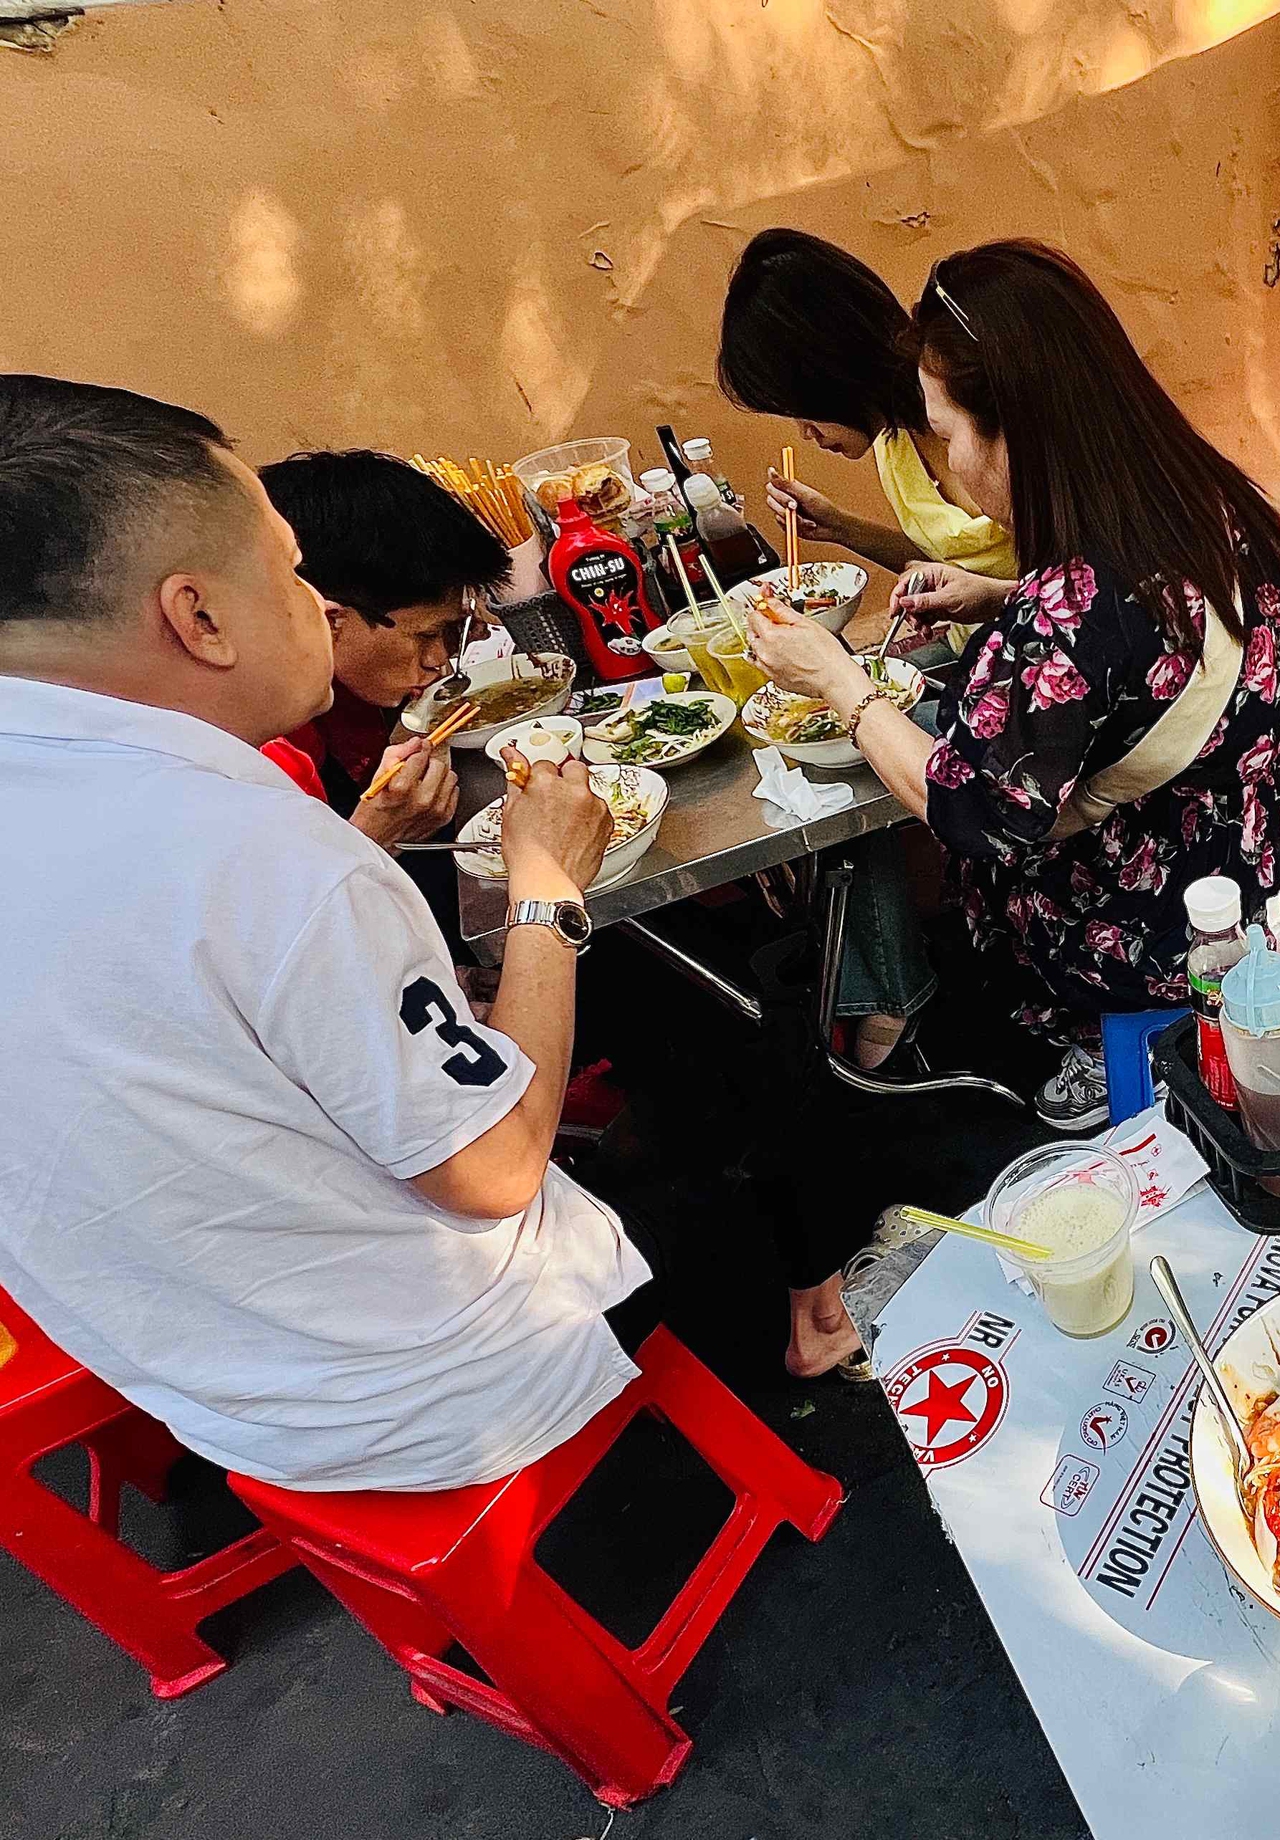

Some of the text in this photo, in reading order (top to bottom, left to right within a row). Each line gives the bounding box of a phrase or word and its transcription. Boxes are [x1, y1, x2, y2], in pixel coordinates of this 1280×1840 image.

[571, 557, 625, 581] CHIN-SU
[399, 975, 509, 1087] 3
[1062, 1474, 1081, 1501] CERT
